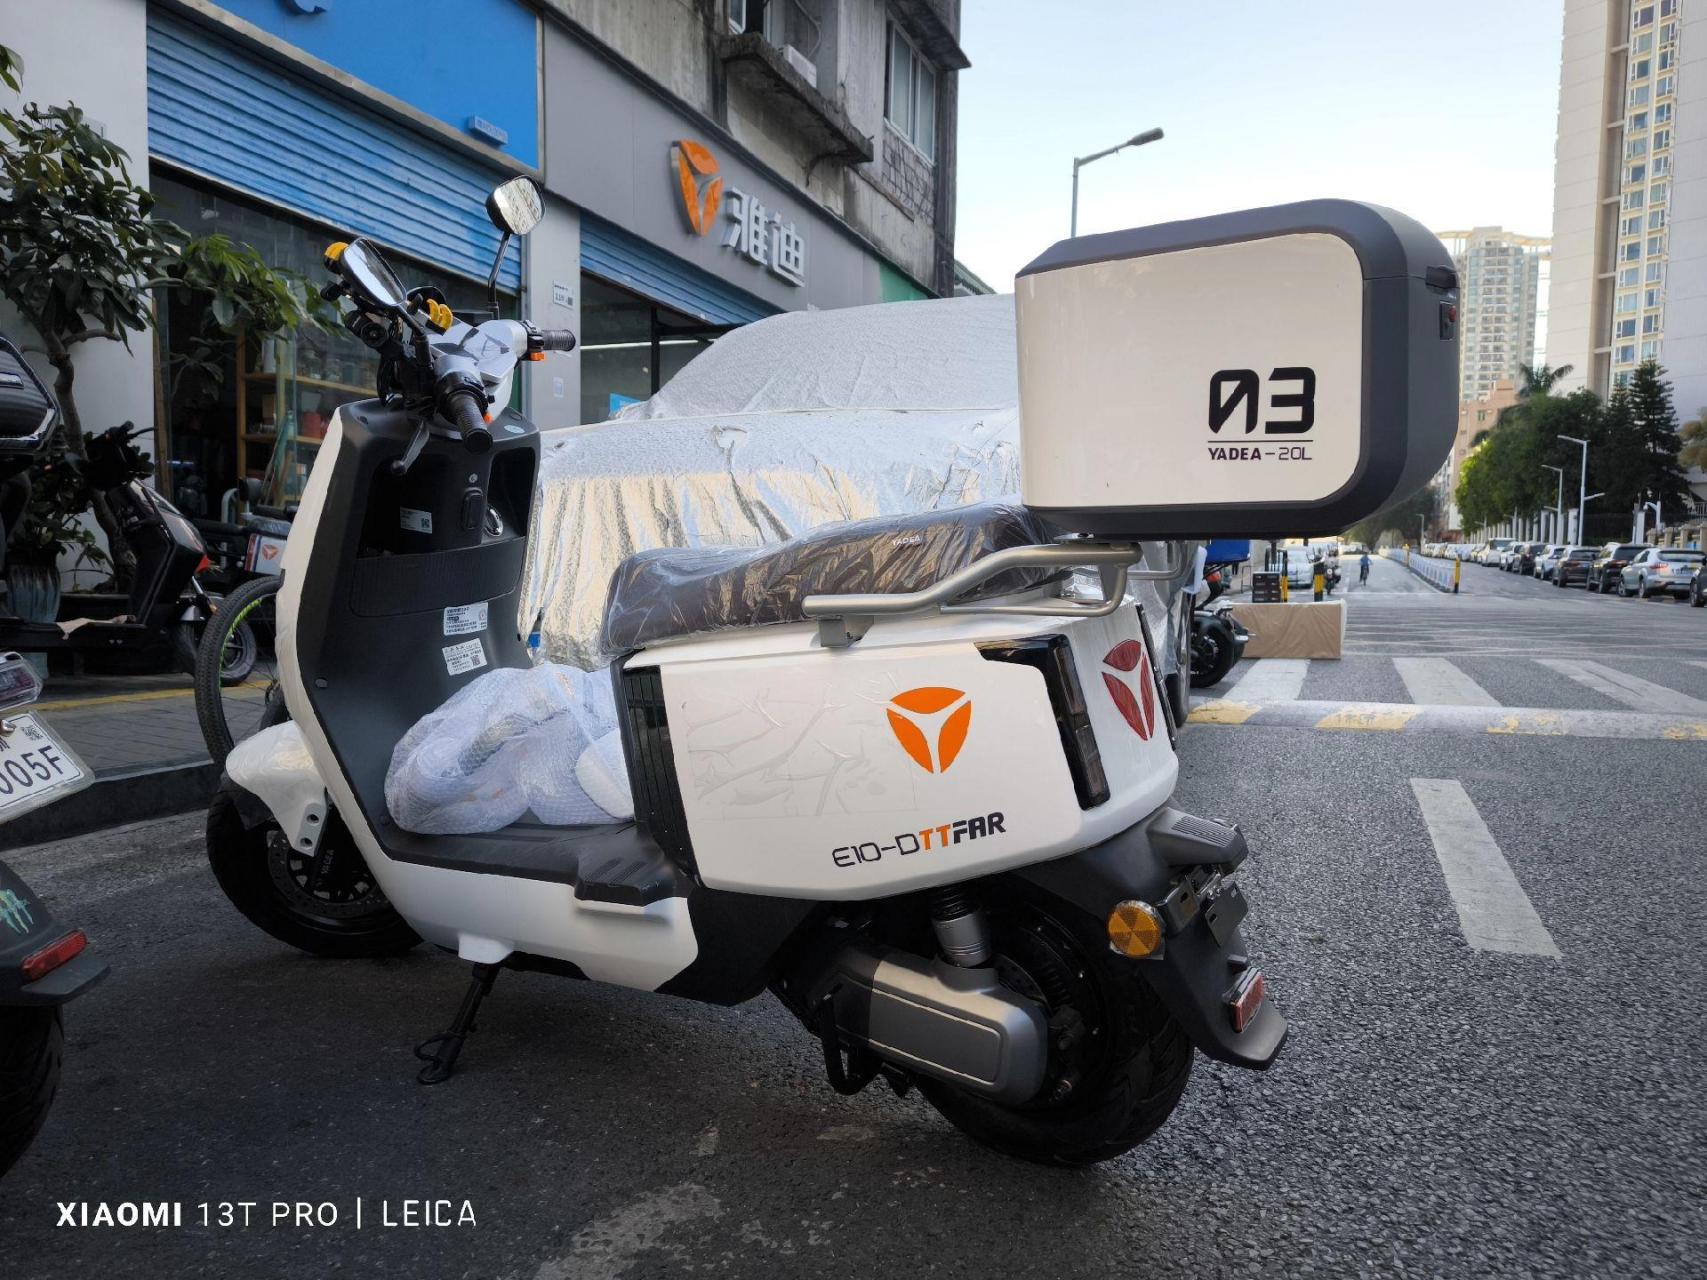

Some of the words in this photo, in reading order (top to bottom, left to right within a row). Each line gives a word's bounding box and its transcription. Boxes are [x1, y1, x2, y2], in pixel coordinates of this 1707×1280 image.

[728, 186, 805, 288] 雅迪
[1208, 366, 1316, 434] 03
[892, 534, 921, 546] YADEA
